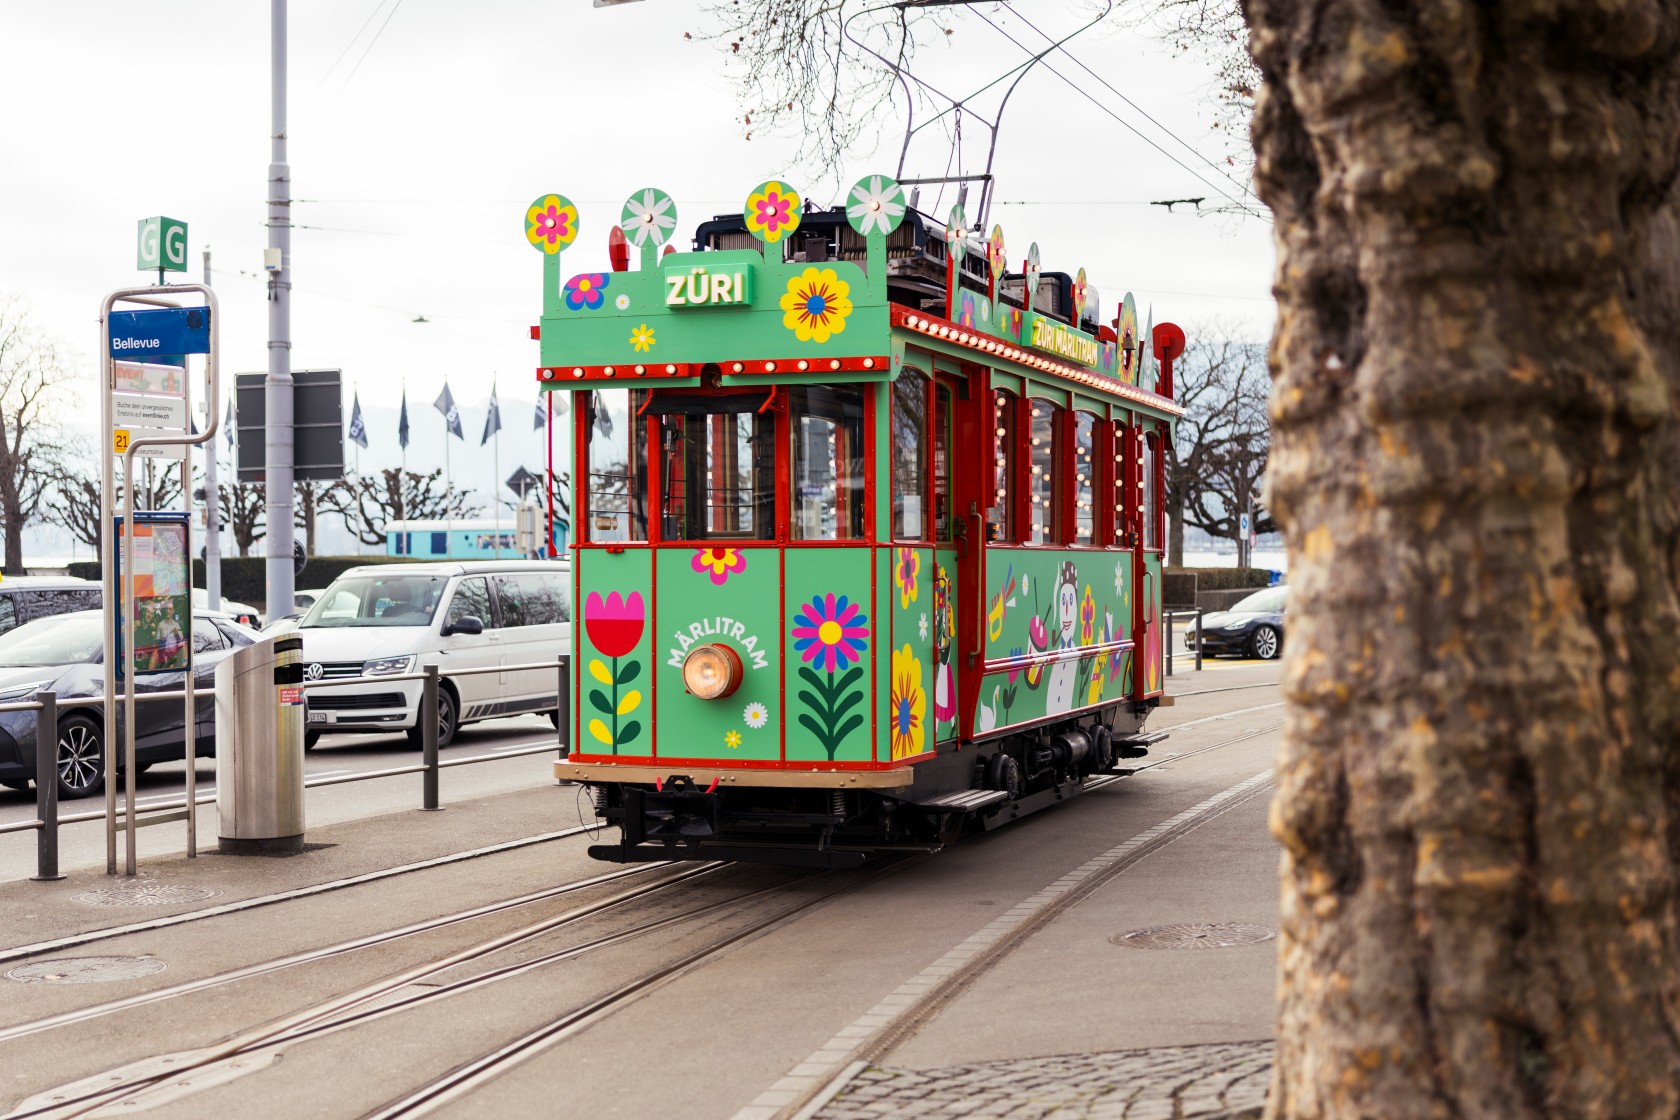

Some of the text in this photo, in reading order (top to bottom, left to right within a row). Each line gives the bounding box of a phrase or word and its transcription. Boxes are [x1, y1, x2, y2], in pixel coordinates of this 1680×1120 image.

[141, 223, 158, 262] G
[165, 225, 184, 264] G
[666, 267, 744, 305] ZÜRI
[112, 337, 160, 350] Bellevue
[1034, 316, 1098, 367] ZÜRI MÄRLITRAM
[116, 435, 129, 448] 21
[137, 448, 164, 456] useumslinie
[667, 616, 768, 670] MÄRLITRAM
